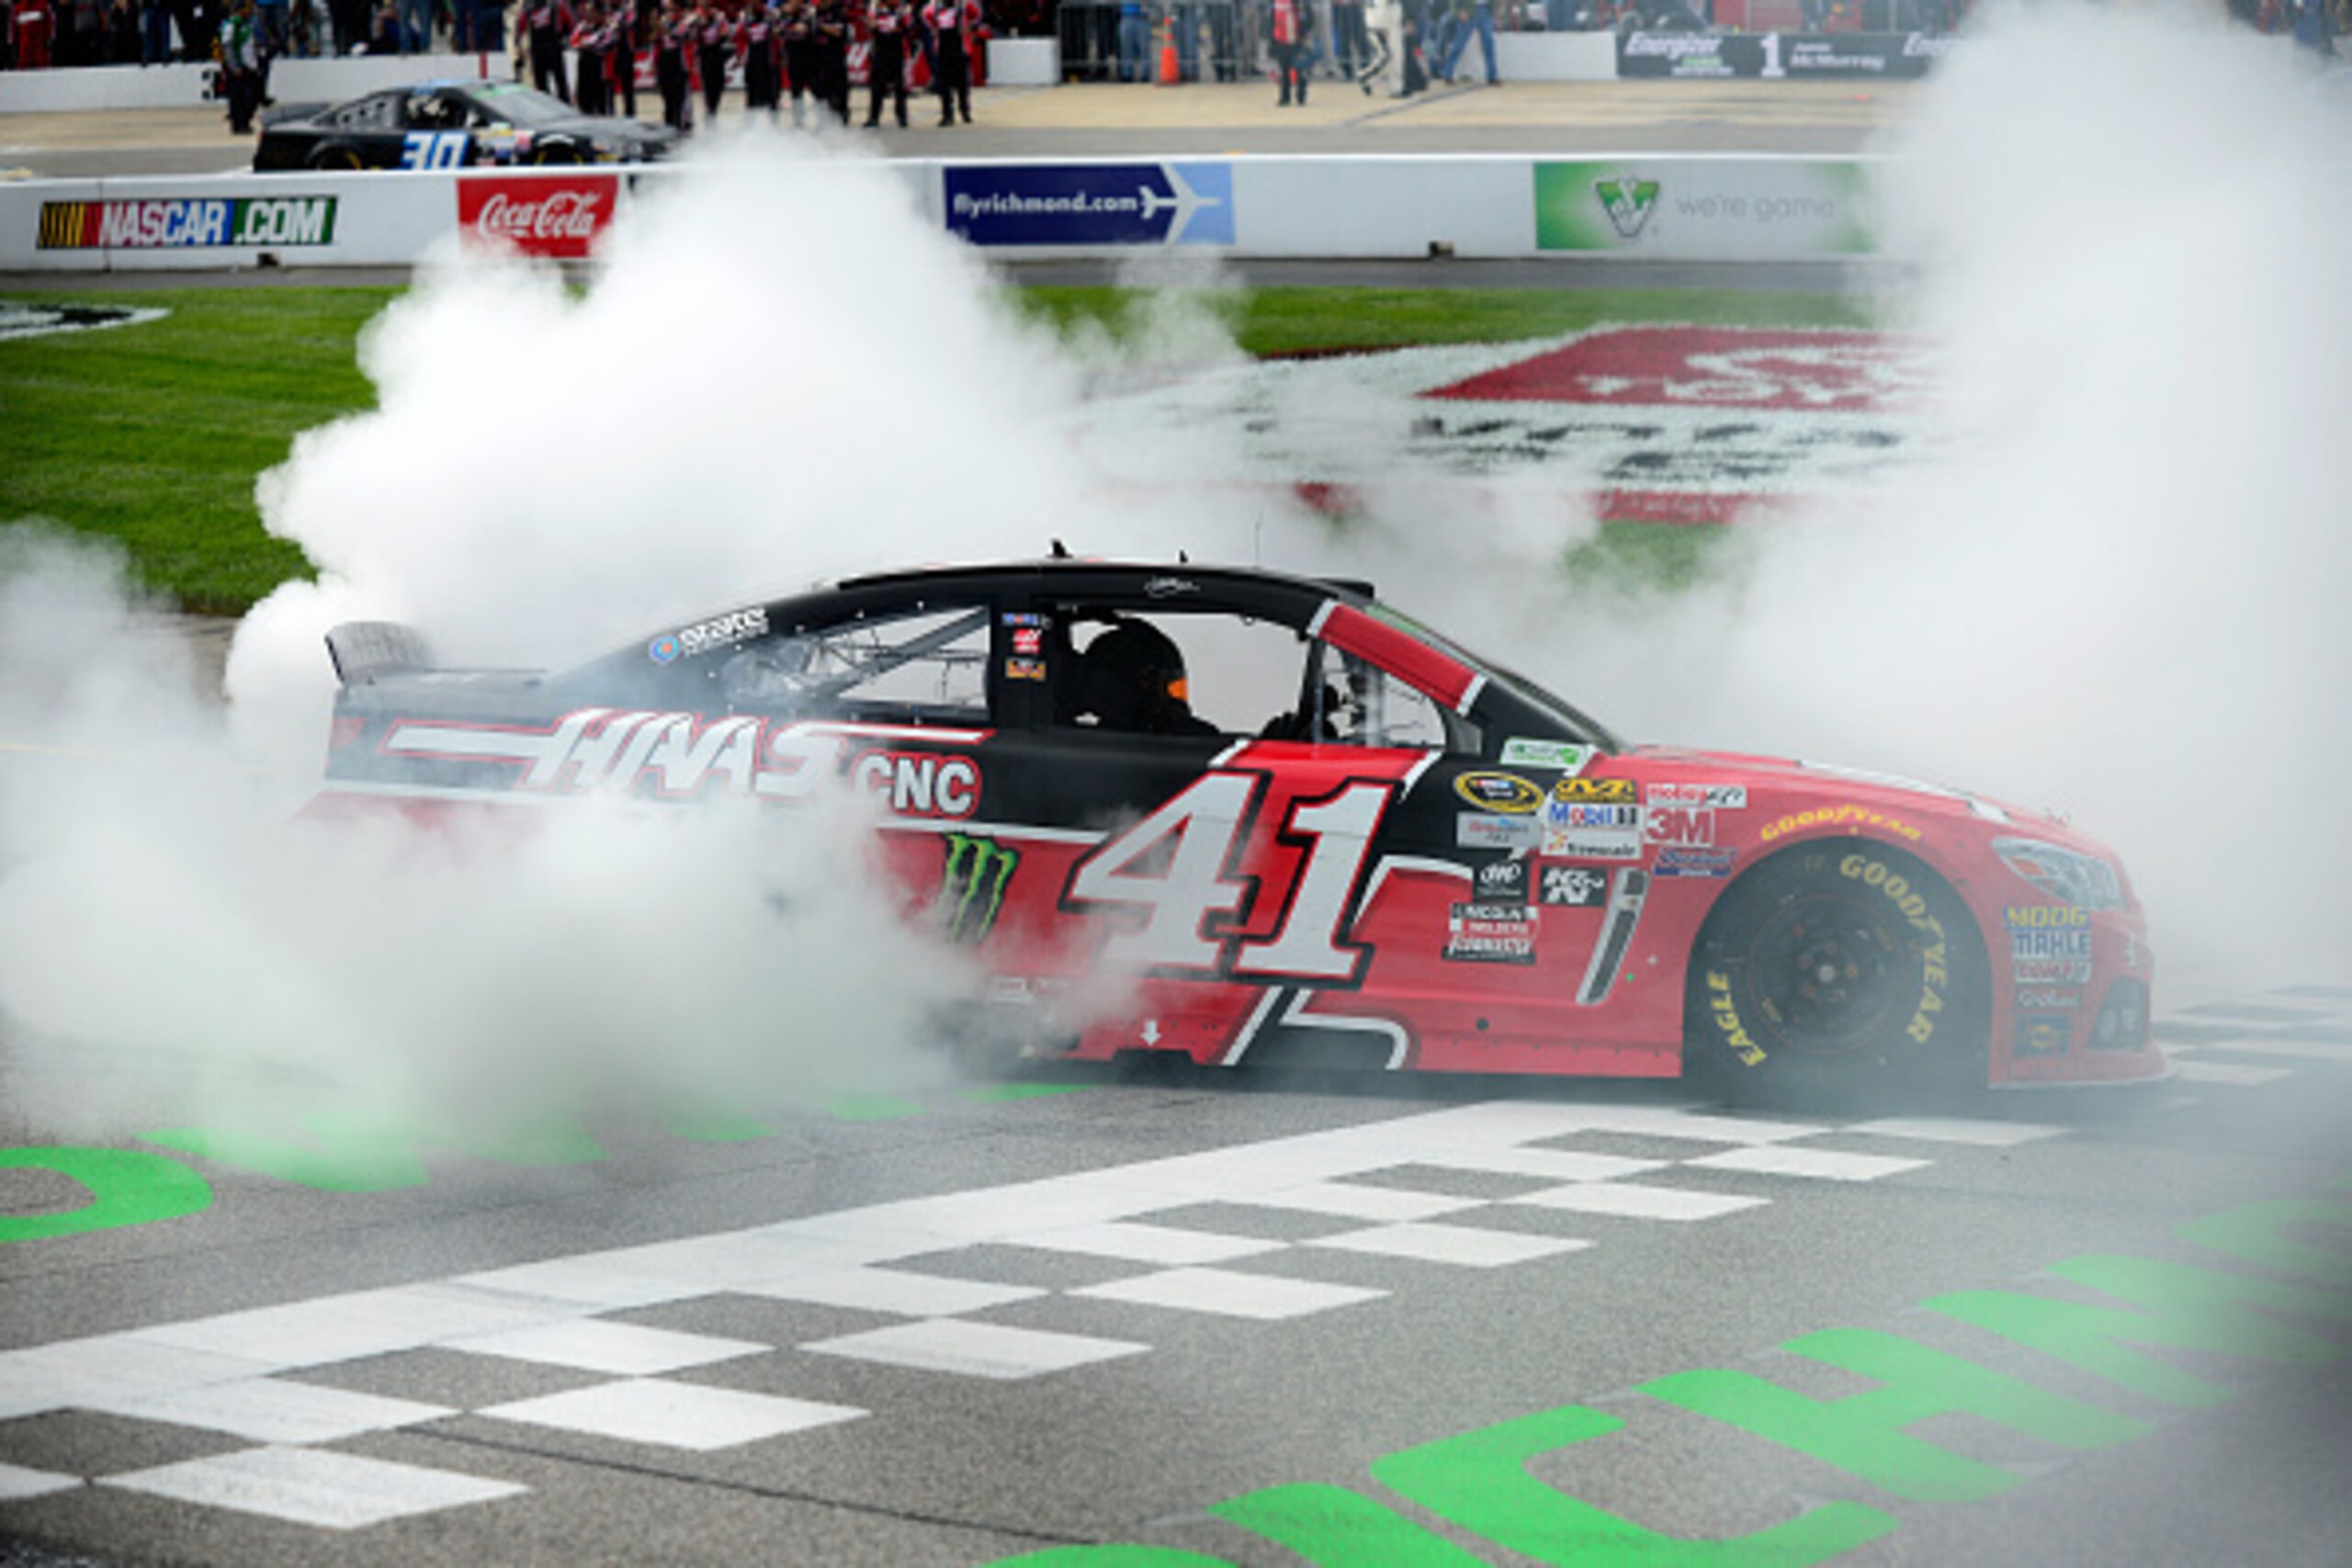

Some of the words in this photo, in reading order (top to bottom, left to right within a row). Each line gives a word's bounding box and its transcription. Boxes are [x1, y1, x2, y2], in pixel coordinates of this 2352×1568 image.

[1760, 33, 1785, 77] 1
[398, 130, 470, 169] 30
[953, 191, 1138, 220] flyrichmond.com
[524, 706, 845, 797] HAAS
[853, 754, 976, 816] CNC
[1646, 807, 1713, 844] 3M
[1760, 804, 1922, 841] GOODYEAR
[1066, 769, 1395, 979] 41
[2007, 906, 2088, 928] MOOG
[1840, 853, 1947, 1044] GOODYEAR
[2015, 933, 2088, 955] MAHLE
[1706, 968, 1768, 1066] EAGLE
